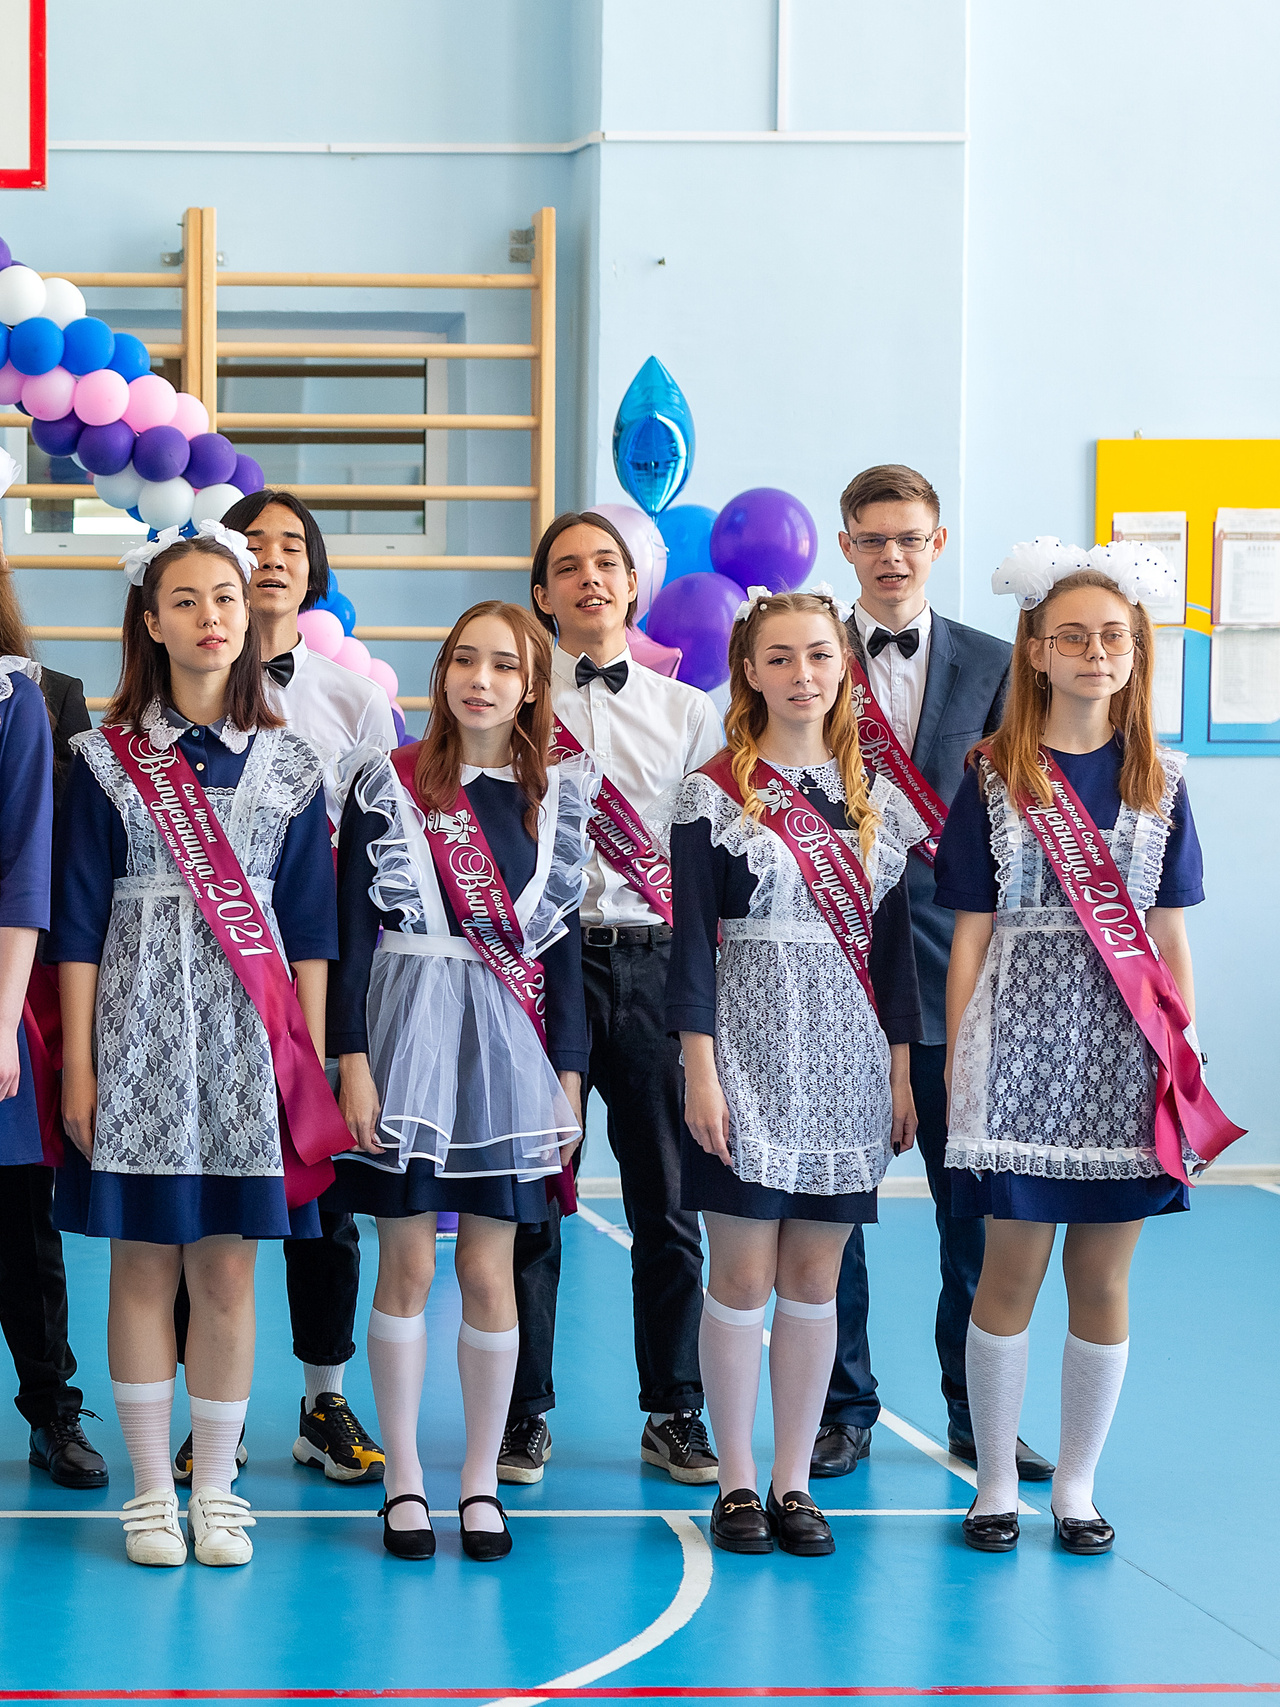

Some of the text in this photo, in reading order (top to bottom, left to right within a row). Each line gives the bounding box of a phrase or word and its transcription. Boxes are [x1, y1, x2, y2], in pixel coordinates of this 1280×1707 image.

[128, 735, 215, 880] Выпускница
[181, 783, 218, 843] Сим Ирина
[890, 749, 921, 792] Мордовцев
[918, 791, 946, 827] Владисла
[164, 831, 178, 848] СОШ
[586, 822, 599, 836] БОУ
[608, 799, 651, 847] Константин
[1042, 834, 1056, 850] СОШ
[1050, 780, 1105, 866] Насырова Софья
[631, 848, 672, 903] 202
[784, 807, 870, 950] Выпускница
[827, 842, 870, 911] Монастырная
[202, 879, 273, 957] 2021
[449, 844, 526, 981] Выпускница
[489, 888, 513, 932] Козлова
[825, 909, 840, 925] СОШ
[1079, 881, 1146, 960] 2021
